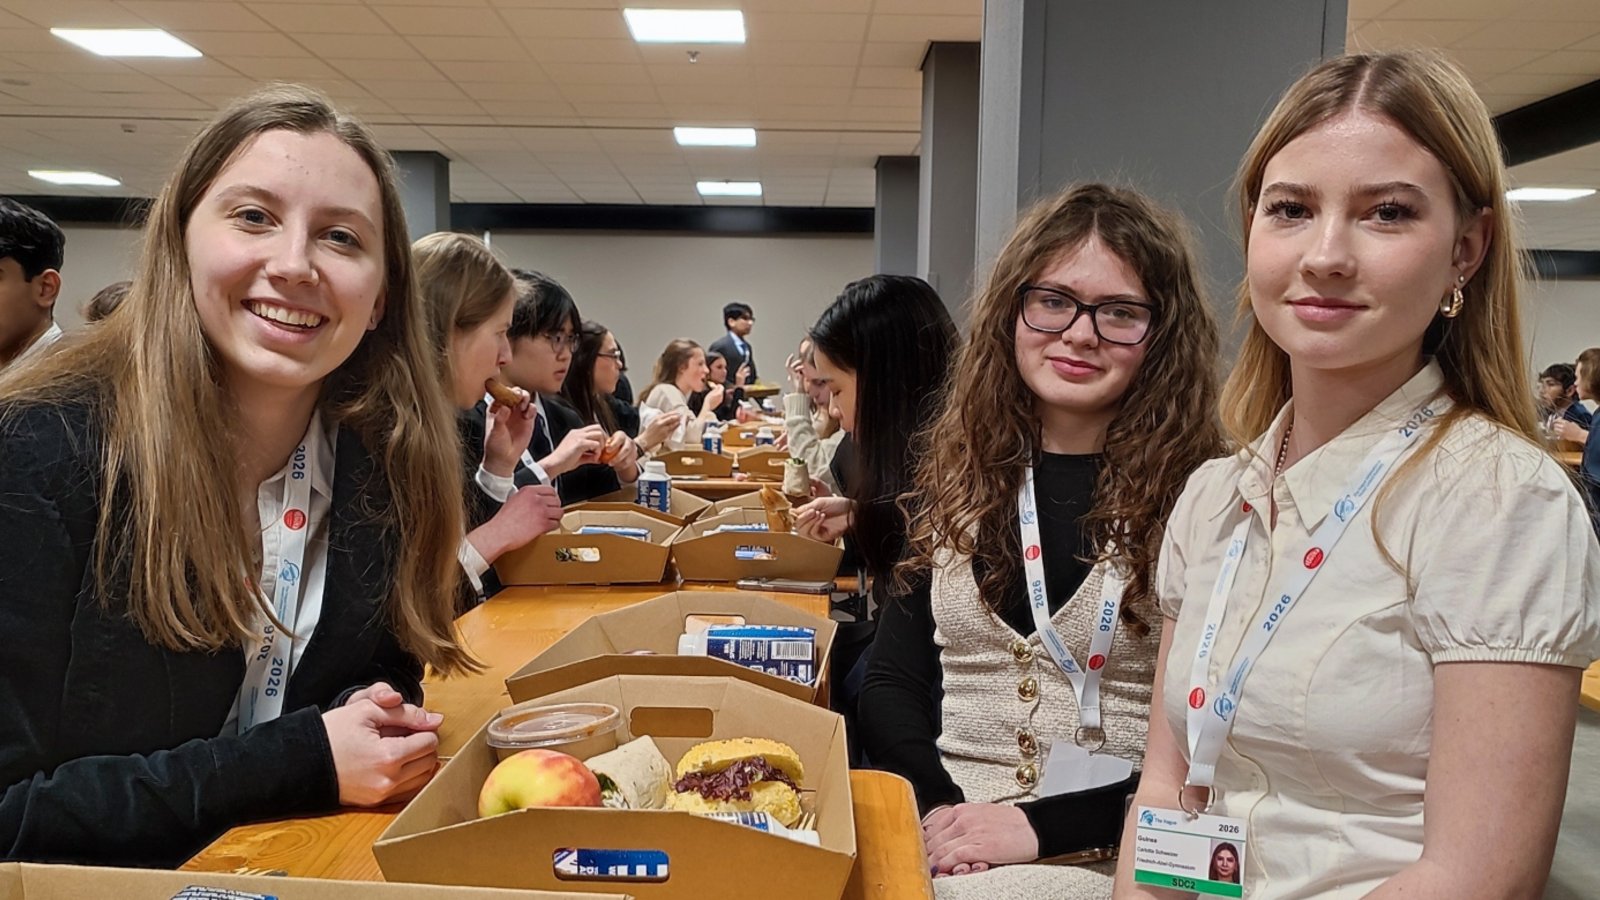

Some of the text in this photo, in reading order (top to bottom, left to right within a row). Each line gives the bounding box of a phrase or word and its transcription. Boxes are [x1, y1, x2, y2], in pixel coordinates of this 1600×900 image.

[1398, 406, 1434, 438] 2026
[292, 445, 306, 480] 2026
[1032, 579, 1044, 609] 2026
[1100, 600, 1115, 632] 2026
[1263, 594, 1292, 632] 2026
[257, 625, 275, 661] 2026
[265, 657, 283, 696] 2026
[1218, 824, 1239, 834] 2026
[1172, 878, 1196, 890] SDC2
